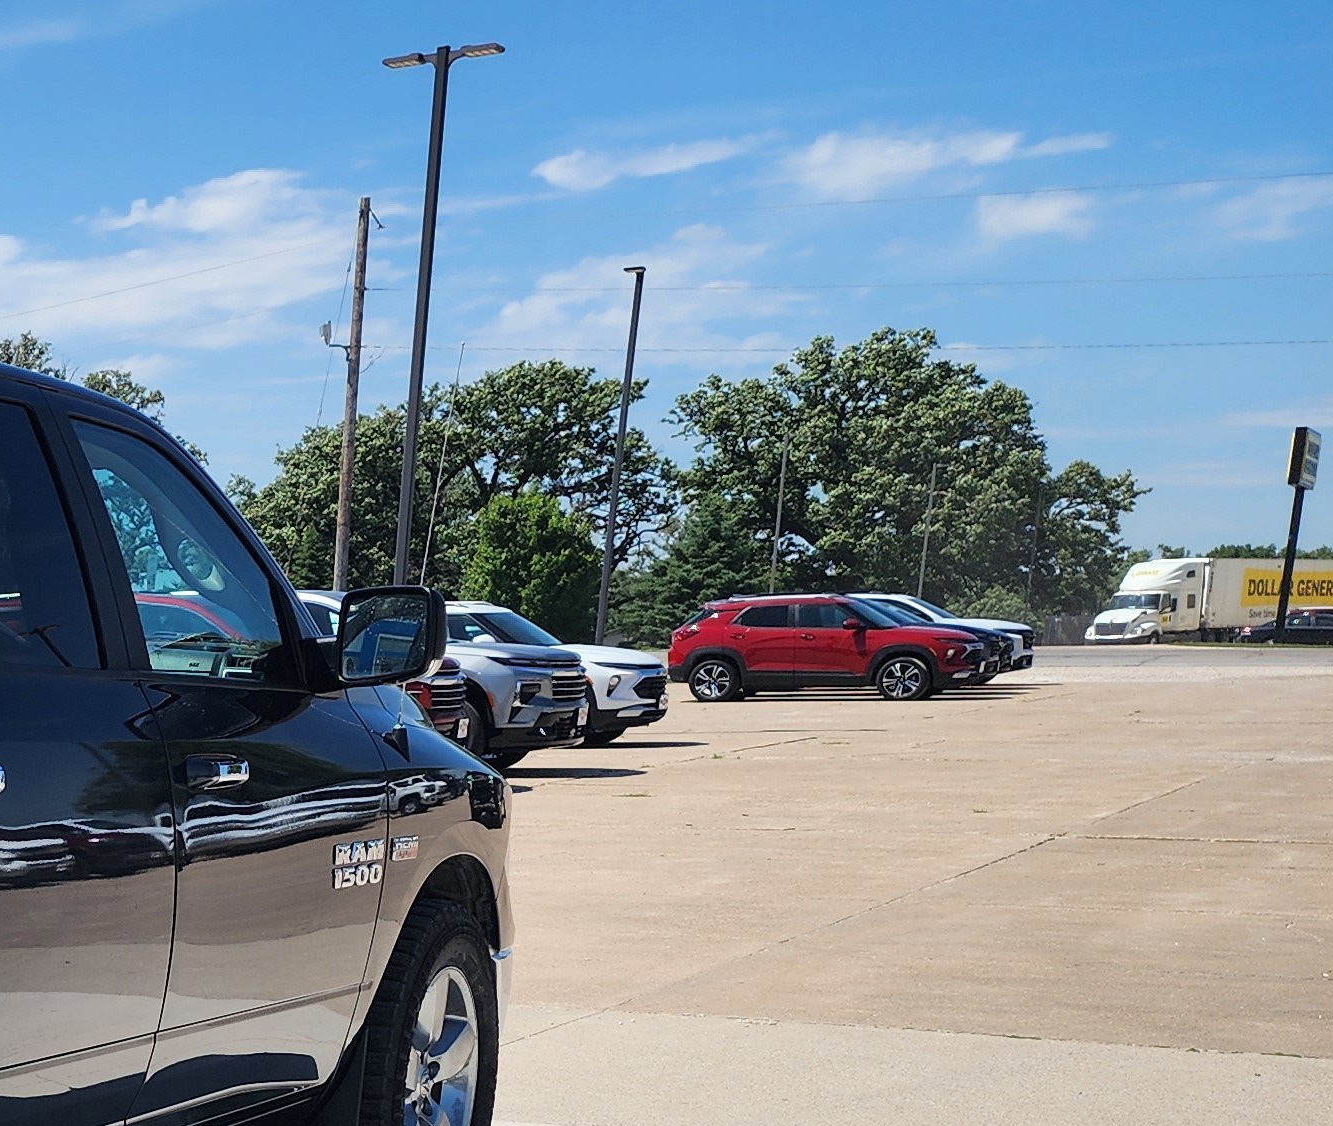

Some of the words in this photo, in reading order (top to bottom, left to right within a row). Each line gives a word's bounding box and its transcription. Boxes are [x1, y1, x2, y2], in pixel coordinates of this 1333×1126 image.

[1247, 578, 1294, 597] DOLLR
[333, 839, 385, 866] RAM
[333, 862, 383, 890] 1500
